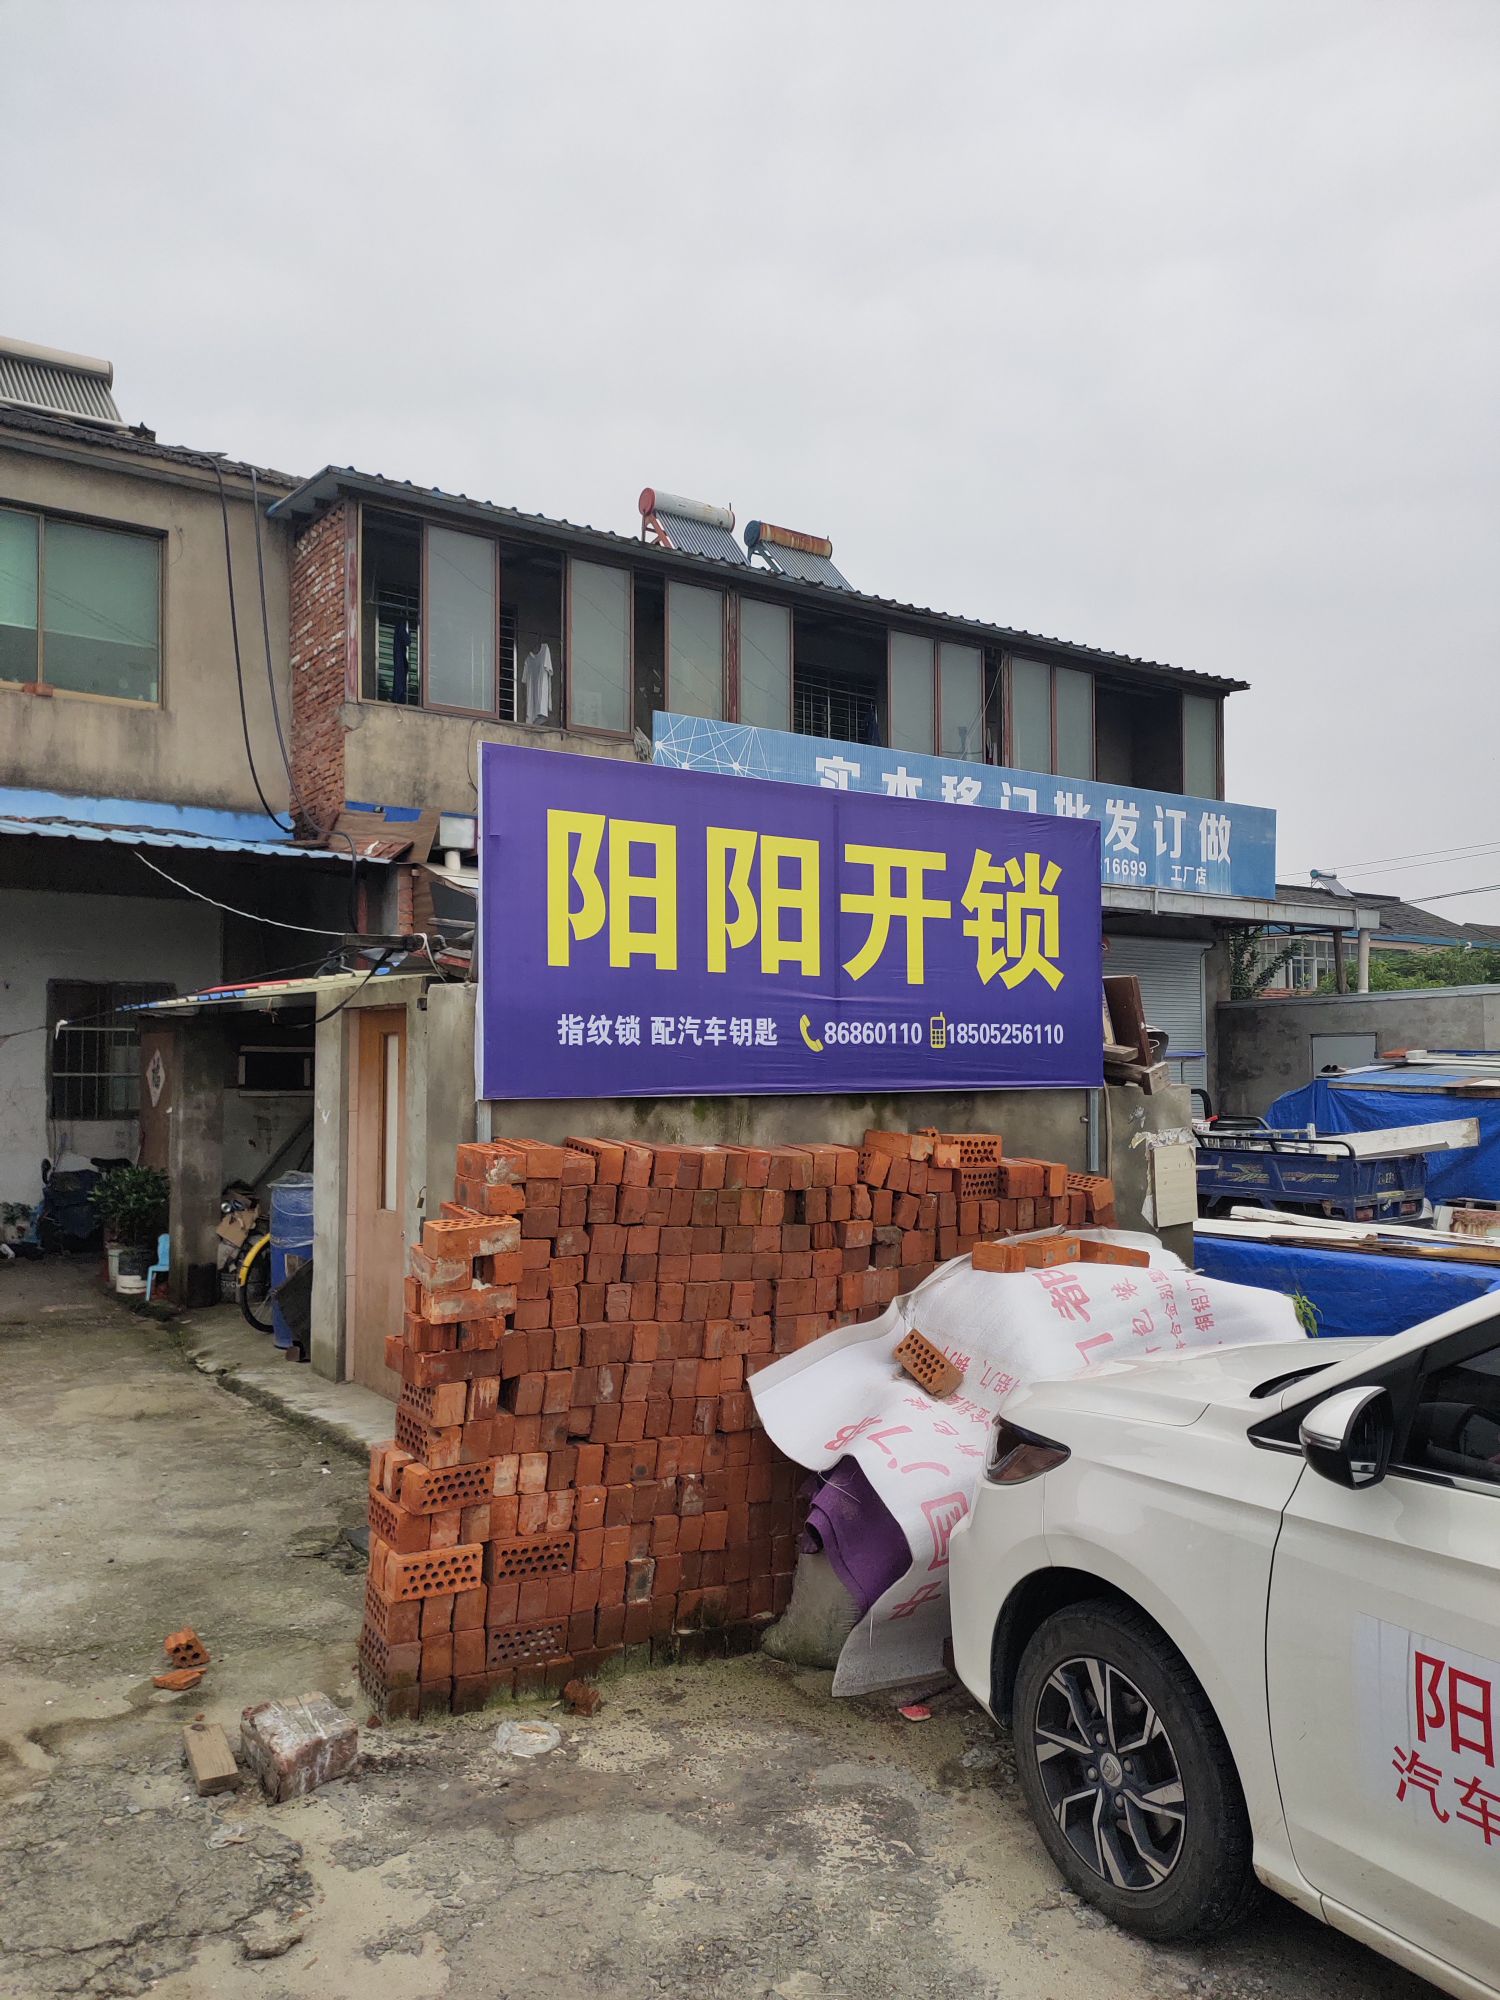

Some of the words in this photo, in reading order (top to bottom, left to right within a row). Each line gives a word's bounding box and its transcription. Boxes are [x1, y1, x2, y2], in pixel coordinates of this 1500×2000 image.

[546, 808, 1065, 990] 阳阳开锁
[1101, 857, 1147, 878] 16699
[1170, 865, 1207, 885] 工厂店
[557, 1013, 641, 1046] 指纹锁
[650, 1015, 779, 1047] 配汽车钥匙
[824, 1021, 923, 1046] 86860110
[946, 1022, 1064, 1046] 18505256110
[1414, 1651, 1496, 1768] 阳
[1392, 1745, 1500, 1846] 汽车
